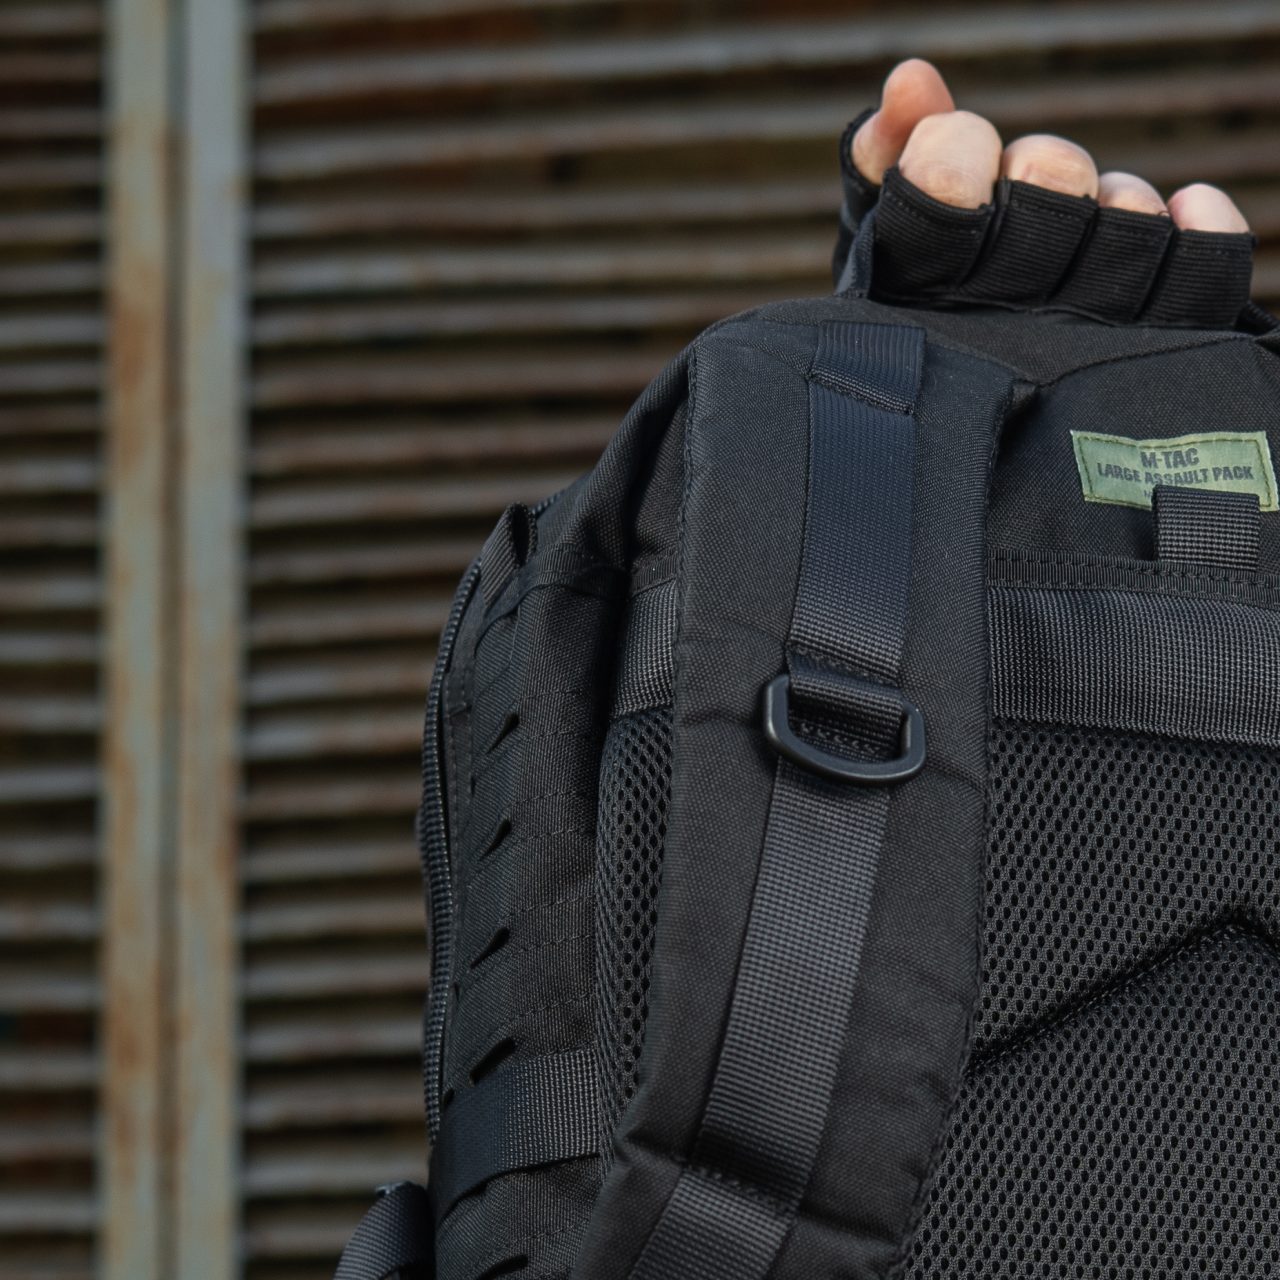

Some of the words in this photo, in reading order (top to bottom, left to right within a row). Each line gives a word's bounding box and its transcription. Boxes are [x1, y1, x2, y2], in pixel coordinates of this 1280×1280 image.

[1140, 447, 1200, 469] M-TAC
[1096, 462, 1142, 483] LARGE
[1144, 468, 1210, 486] ASSAULT
[1212, 465, 1254, 484] PACK
